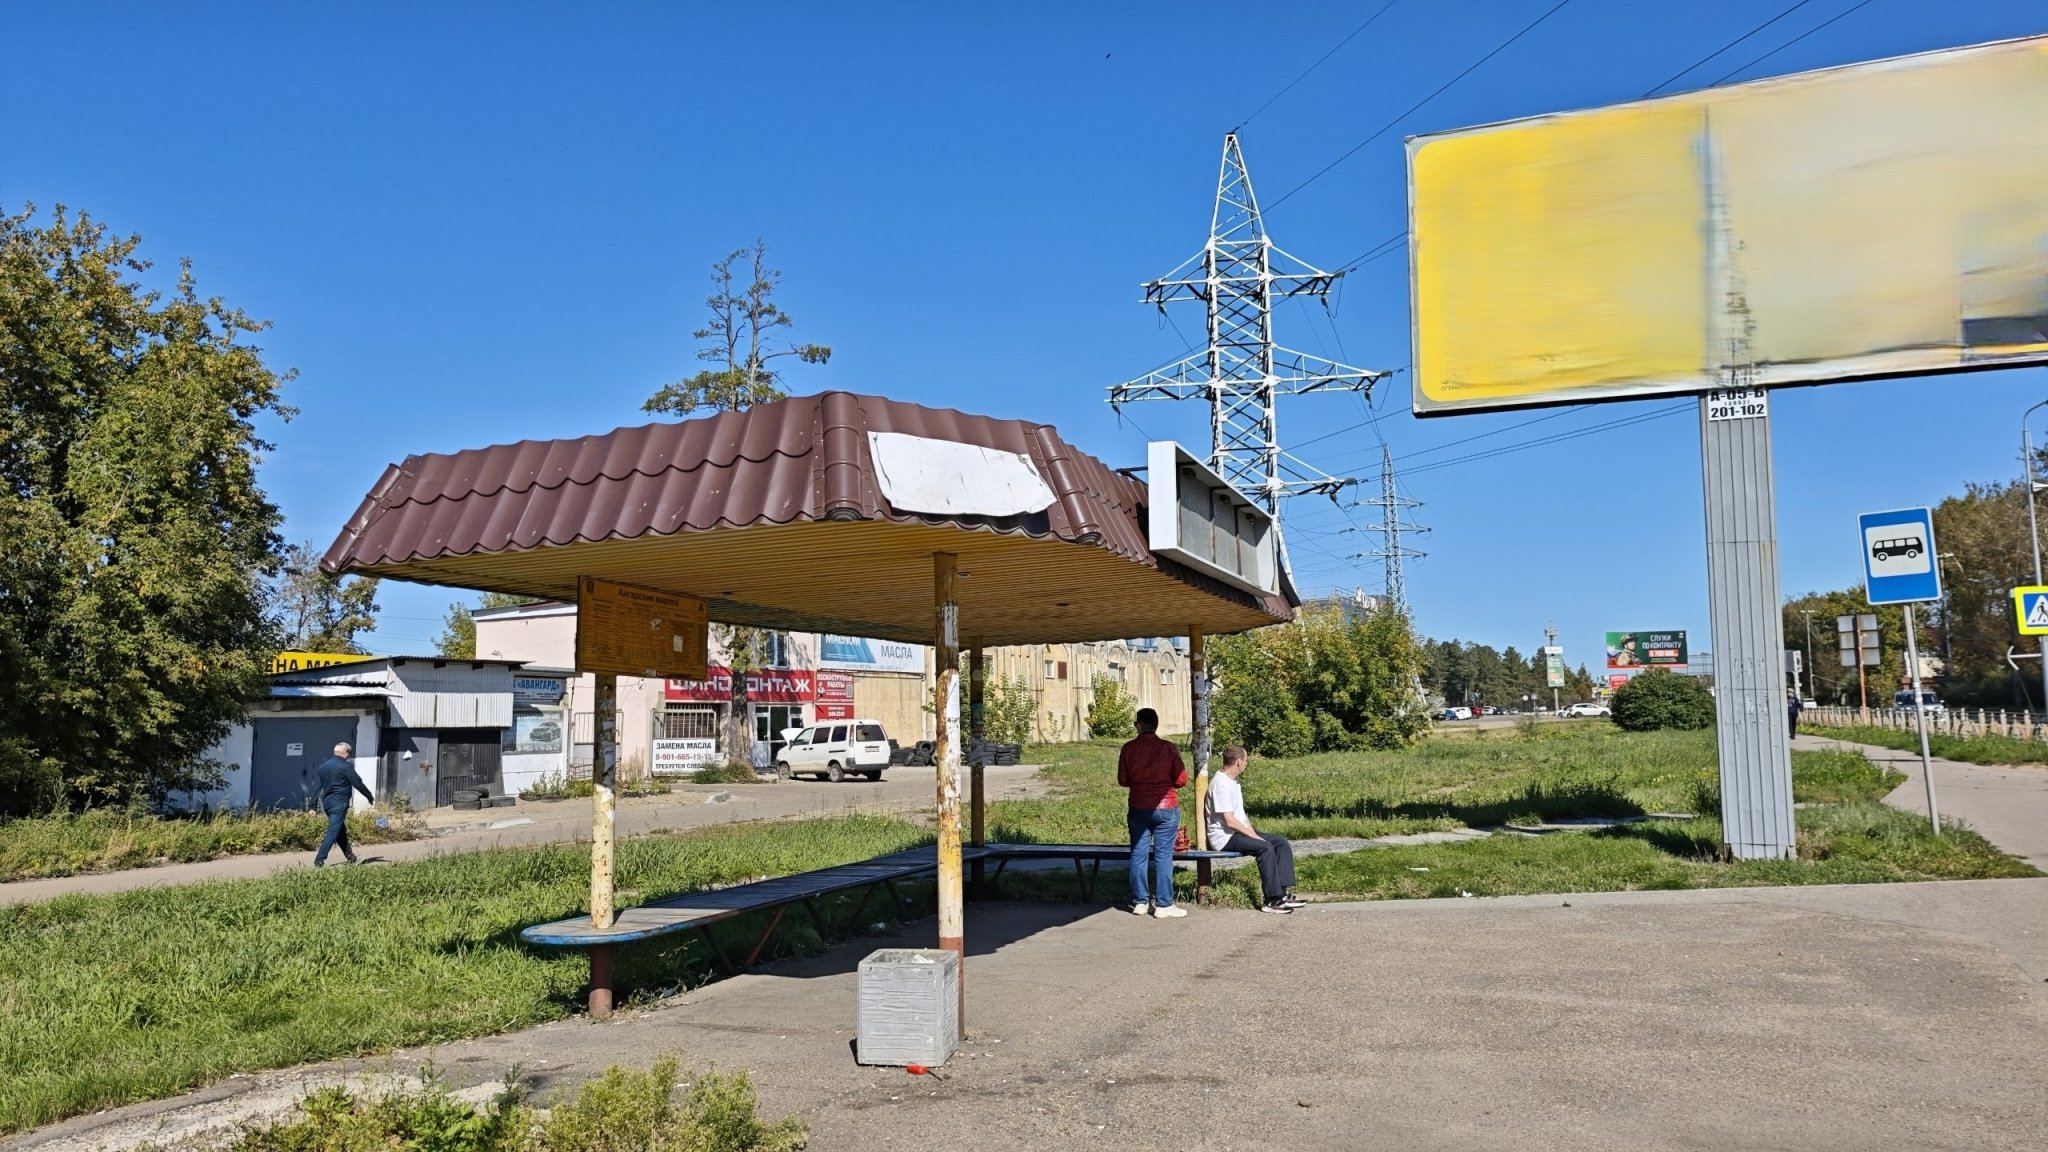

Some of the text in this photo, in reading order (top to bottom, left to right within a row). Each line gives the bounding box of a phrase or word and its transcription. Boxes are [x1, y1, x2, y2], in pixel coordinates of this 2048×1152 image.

[1711, 404, 1764, 418] 201-102
[655, 596, 679, 607] ворота
[1650, 634, 1671, 642] СЛУЖИ
[1650, 641, 1682, 649] КОНТРАКТУ
[881, 645, 912, 659] МАСЛА
[517, 680, 560, 691] «АВАНГАРД»
[669, 675, 811, 692] ШИНООНТАЖ
[656, 742, 712, 750] ЗАМЕНА МАСЛА
[656, 753, 712, 761] 8-901-665-15-15
